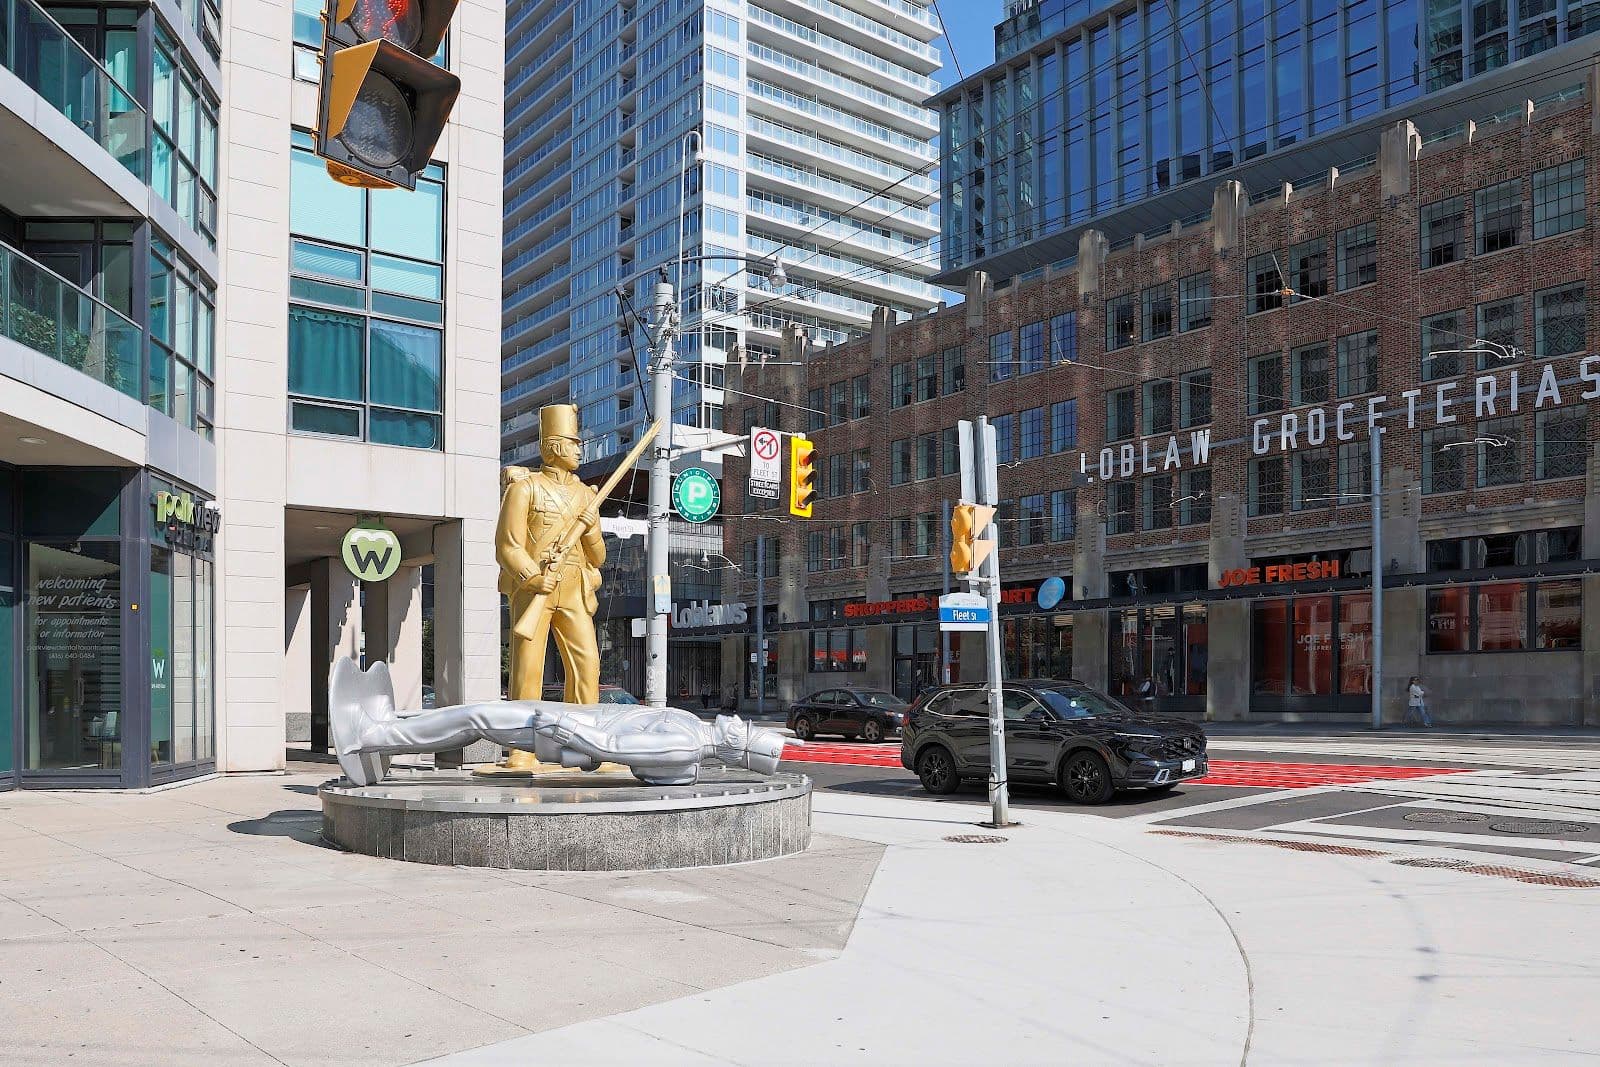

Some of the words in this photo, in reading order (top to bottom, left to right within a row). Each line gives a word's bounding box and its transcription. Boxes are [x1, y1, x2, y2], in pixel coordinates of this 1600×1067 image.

[1081, 429, 1210, 482] LOBLAW
[1253, 355, 1600, 454] GROCETERIAS
[674, 470, 719, 496] MUNICIPAL
[687, 481, 707, 503] P
[675, 498, 717, 520] PARKING
[36, 576, 107, 593] welcoming
[1218, 566, 1260, 587] JOE
[1266, 560, 1339, 582] FRESH
[58, 592, 117, 609] patients
[844, 599, 929, 619] SHOPPERS
[1001, 588, 1035, 604] ART
[50, 616, 109, 627] appointments
[671, 600, 748, 628] Loblaws
[953, 609, 970, 620] Fleet
[53, 629, 104, 638] information
[1297, 634, 1320, 644] JOE
[1324, 632, 1365, 643] FESH
